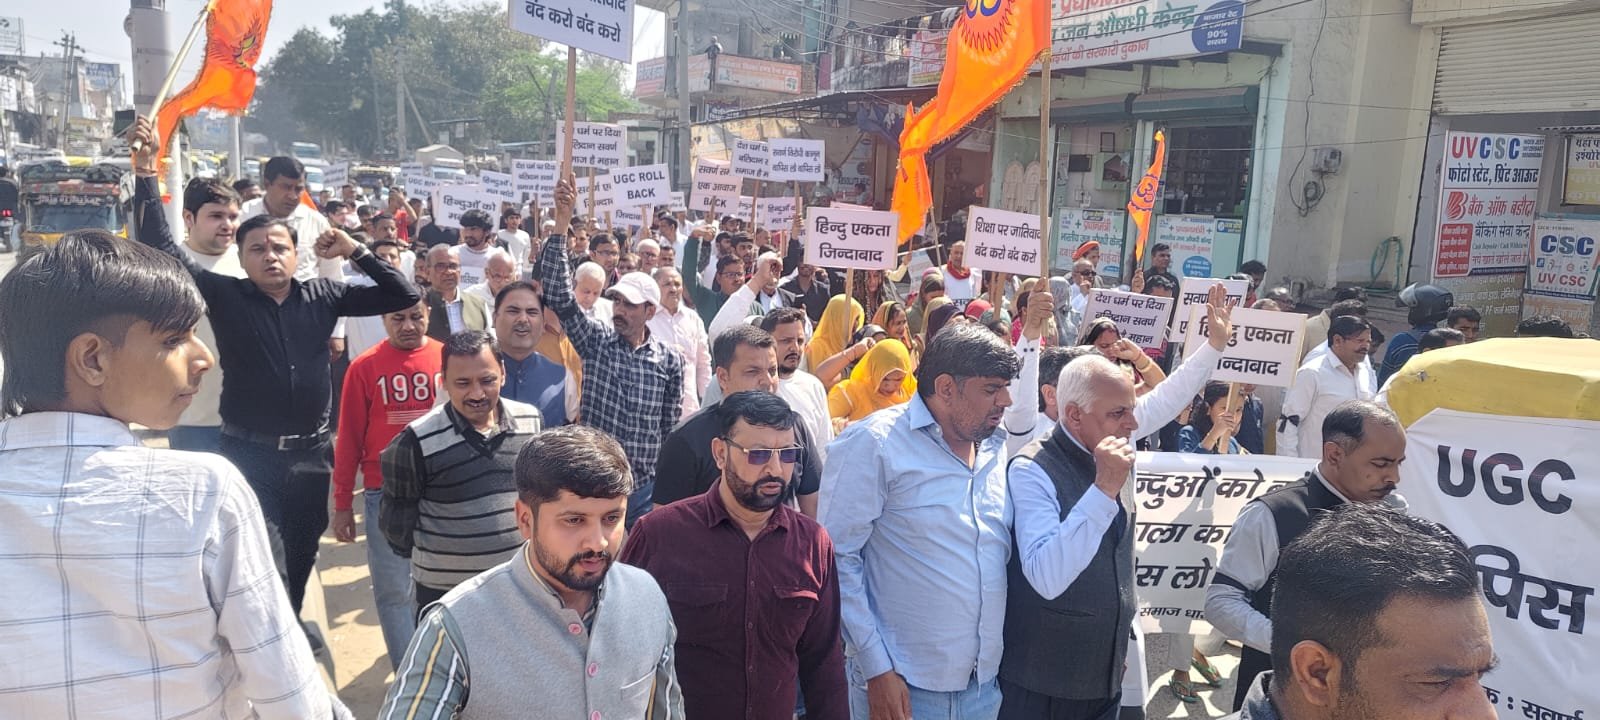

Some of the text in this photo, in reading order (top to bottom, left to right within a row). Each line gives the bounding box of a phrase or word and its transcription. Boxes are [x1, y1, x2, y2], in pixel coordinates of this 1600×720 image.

[525, 0, 620, 42] बंद करो बंद करो
[1207, 29, 1228, 39] 90%
[572, 139, 595, 150] लिदान
[613, 170, 665, 184] UGC ROLL
[1448, 162, 1472, 182] फोटो
[1495, 163, 1512, 183] प्रिंट
[627, 187, 656, 200] BACK
[815, 216, 890, 241] हिन्दु एकता
[975, 216, 996, 233] शिक्षा
[997, 224, 1009, 237] पर
[819, 242, 884, 263] जिन्दाबाद
[974, 243, 1037, 264] बंद करो बंद करो
[1540, 235, 1595, 256] CSC
[1538, 272, 1556, 284] UV
[1559, 274, 1587, 288] CSC
[1095, 292, 1166, 311] देश धर्म पर दिया
[1133, 314, 1157, 328] सवर्ण
[1244, 325, 1294, 345] एकता
[1216, 356, 1281, 376] न्दाबाद
[1136, 465, 1222, 509] न्दुओं
[1215, 468, 1266, 499] को
[1437, 444, 1576, 515] UGC
[1193, 524, 1233, 545] का
[1170, 557, 1214, 589] लो
[1139, 606, 1183, 618] समाज
